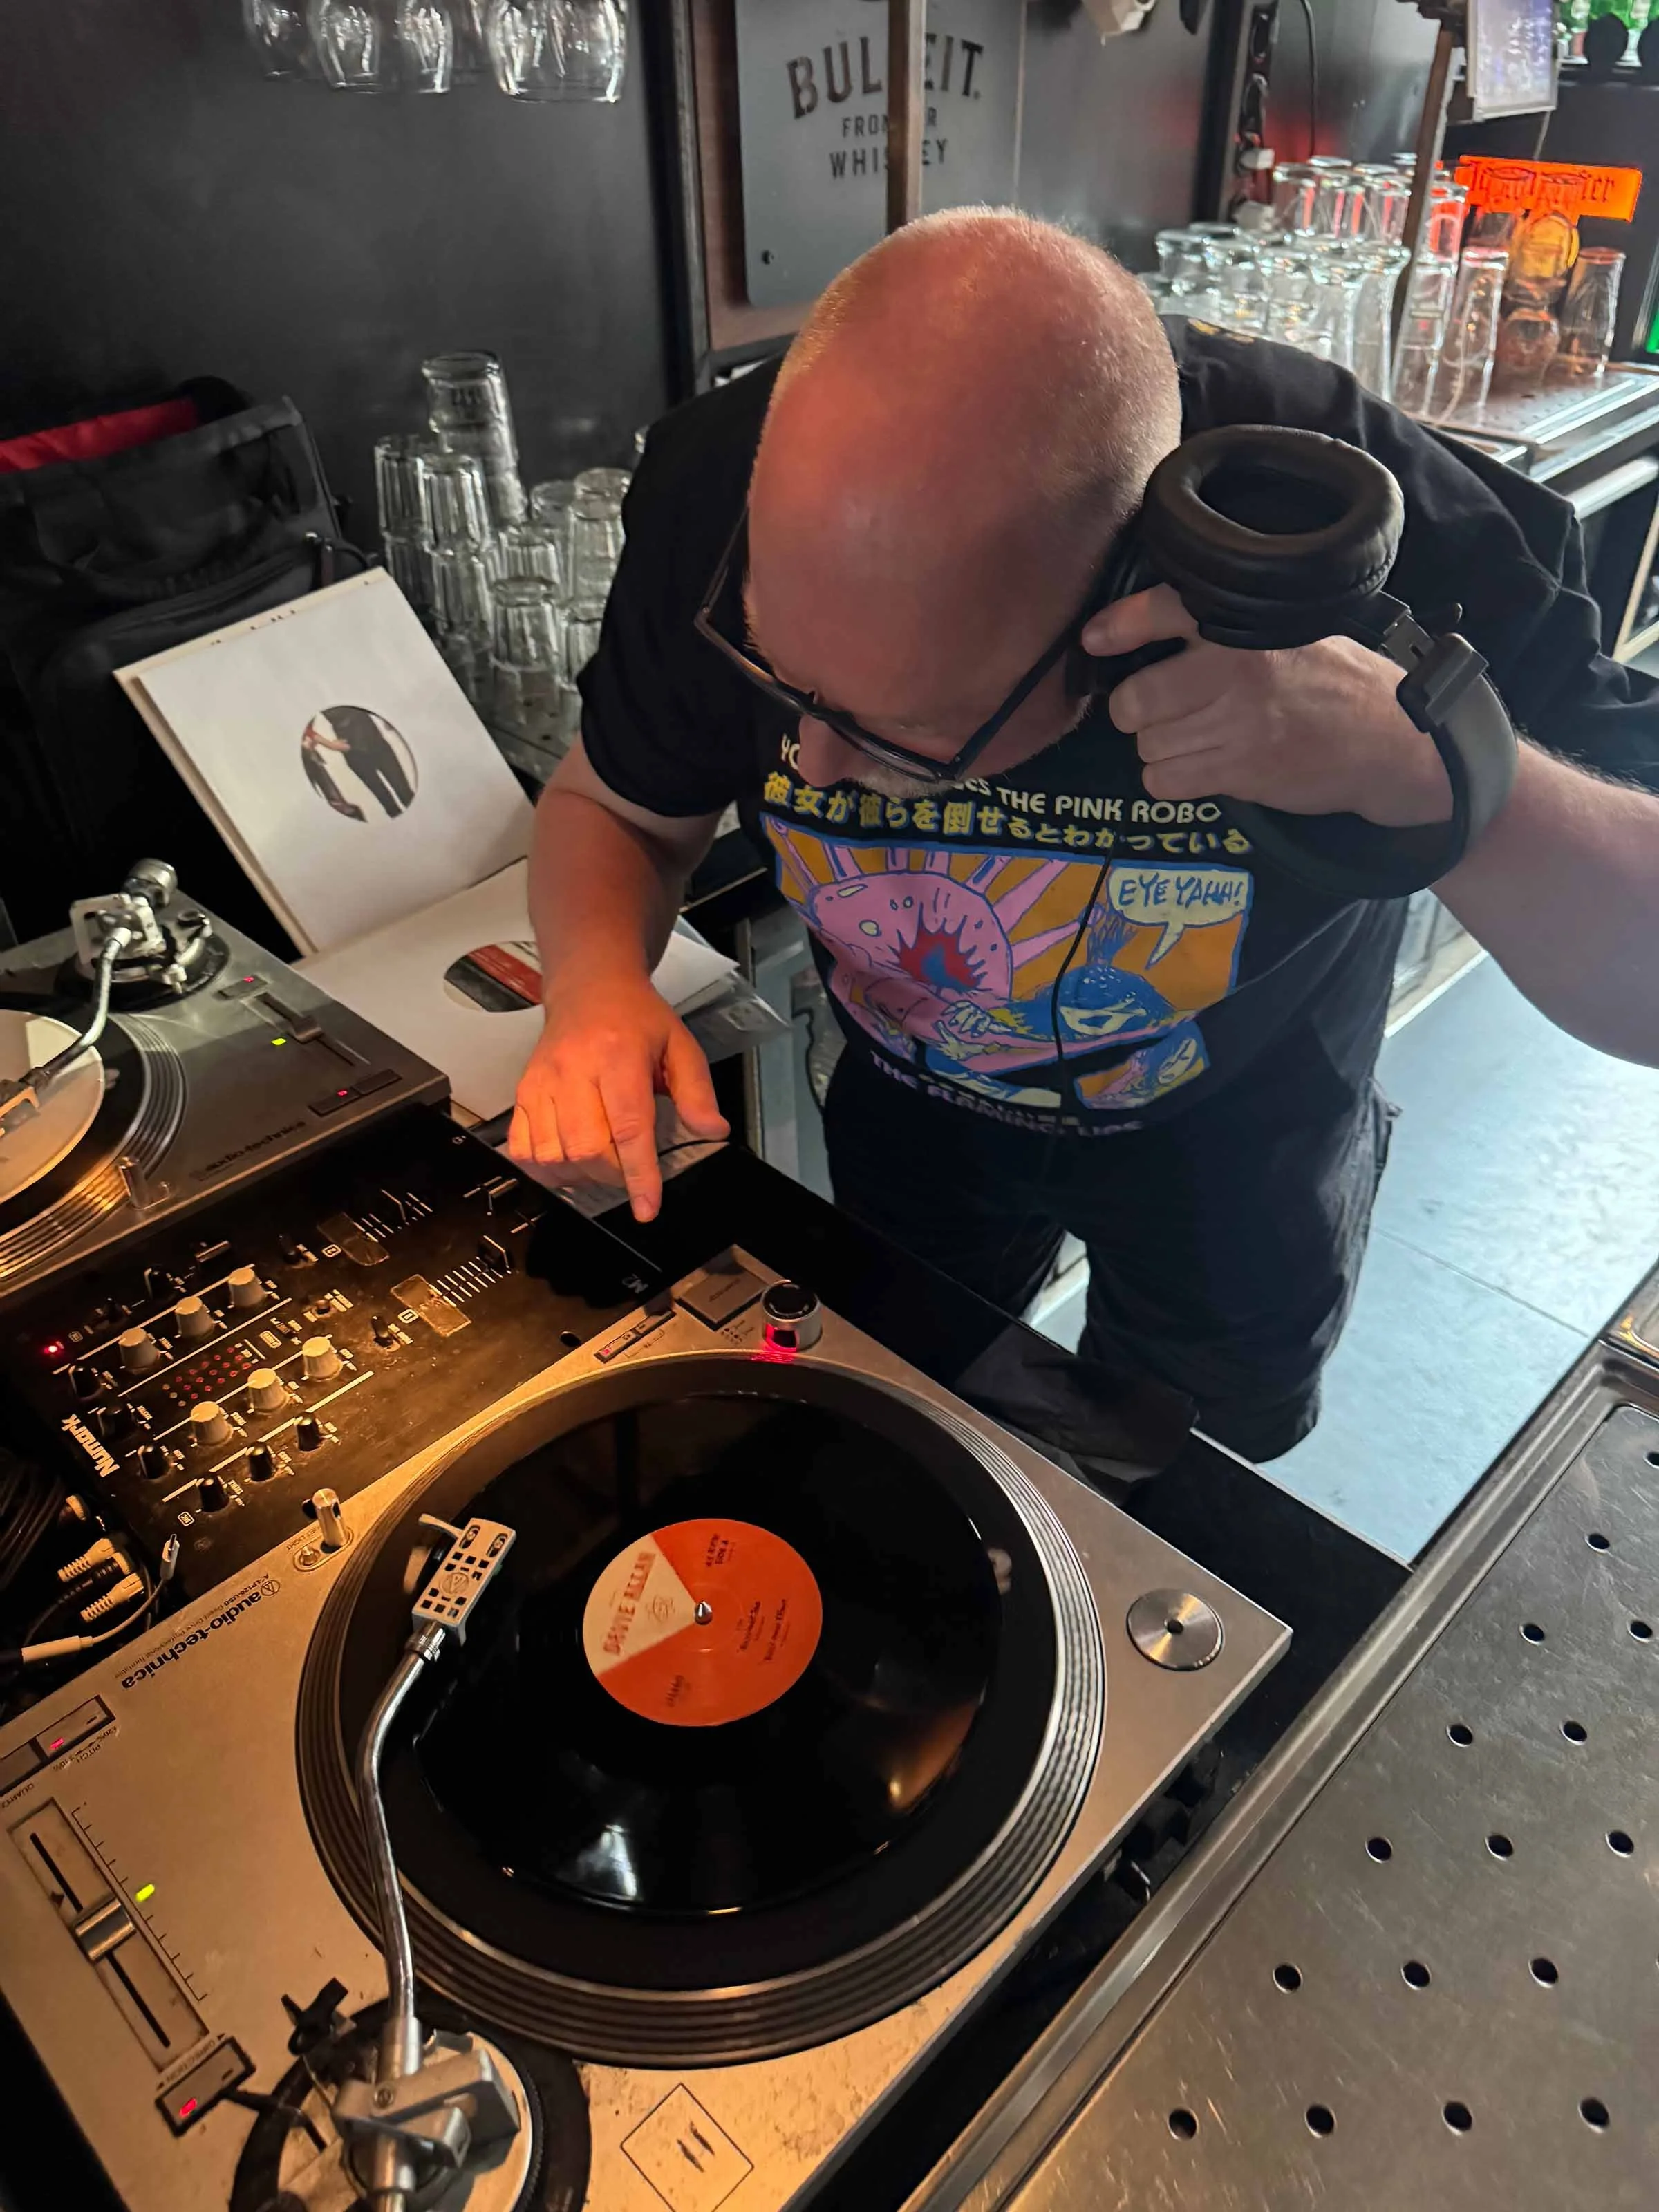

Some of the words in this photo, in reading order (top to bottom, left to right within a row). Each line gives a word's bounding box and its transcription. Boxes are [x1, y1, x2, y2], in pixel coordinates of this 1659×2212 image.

[996, 787, 1047, 814] THE
[1055, 795, 1124, 823] PINK
[1118, 872, 1171, 908] EYE
[61, 1414, 121, 1477] Numark
[120, 1591, 262, 1689] audio-technica
